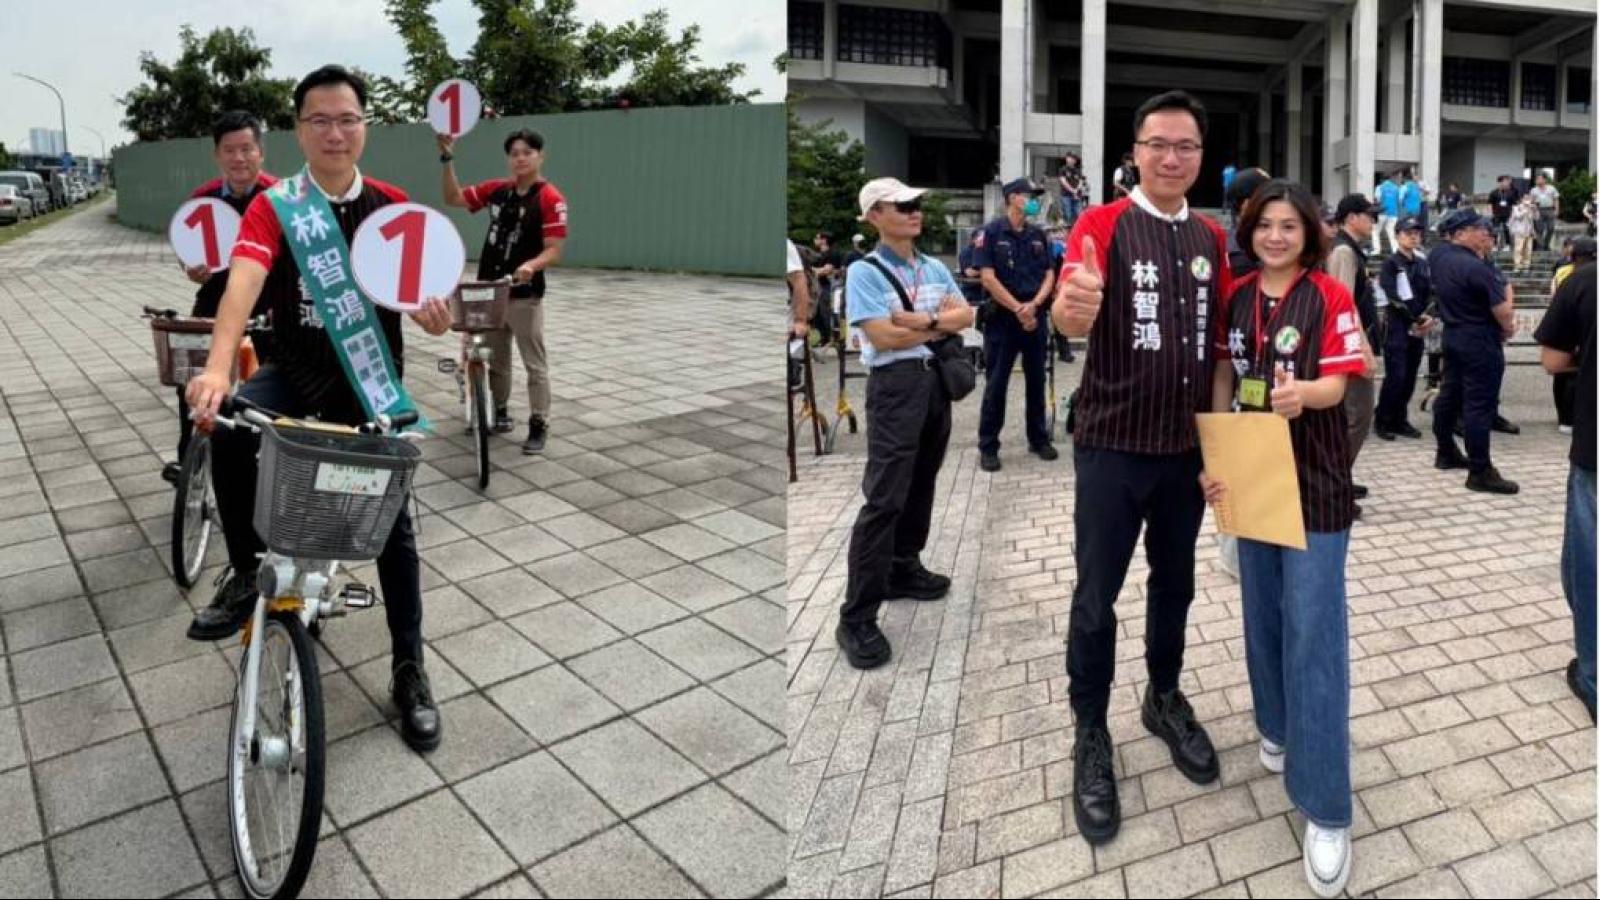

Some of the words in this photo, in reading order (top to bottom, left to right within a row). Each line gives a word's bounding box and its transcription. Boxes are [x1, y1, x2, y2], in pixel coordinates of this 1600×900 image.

[439, 84, 460, 133] 1
[184, 203, 221, 268] 1
[290, 205, 366, 330] 林智鴻
[379, 209, 427, 304] 1
[1131, 259, 1161, 351] 林智鴻
